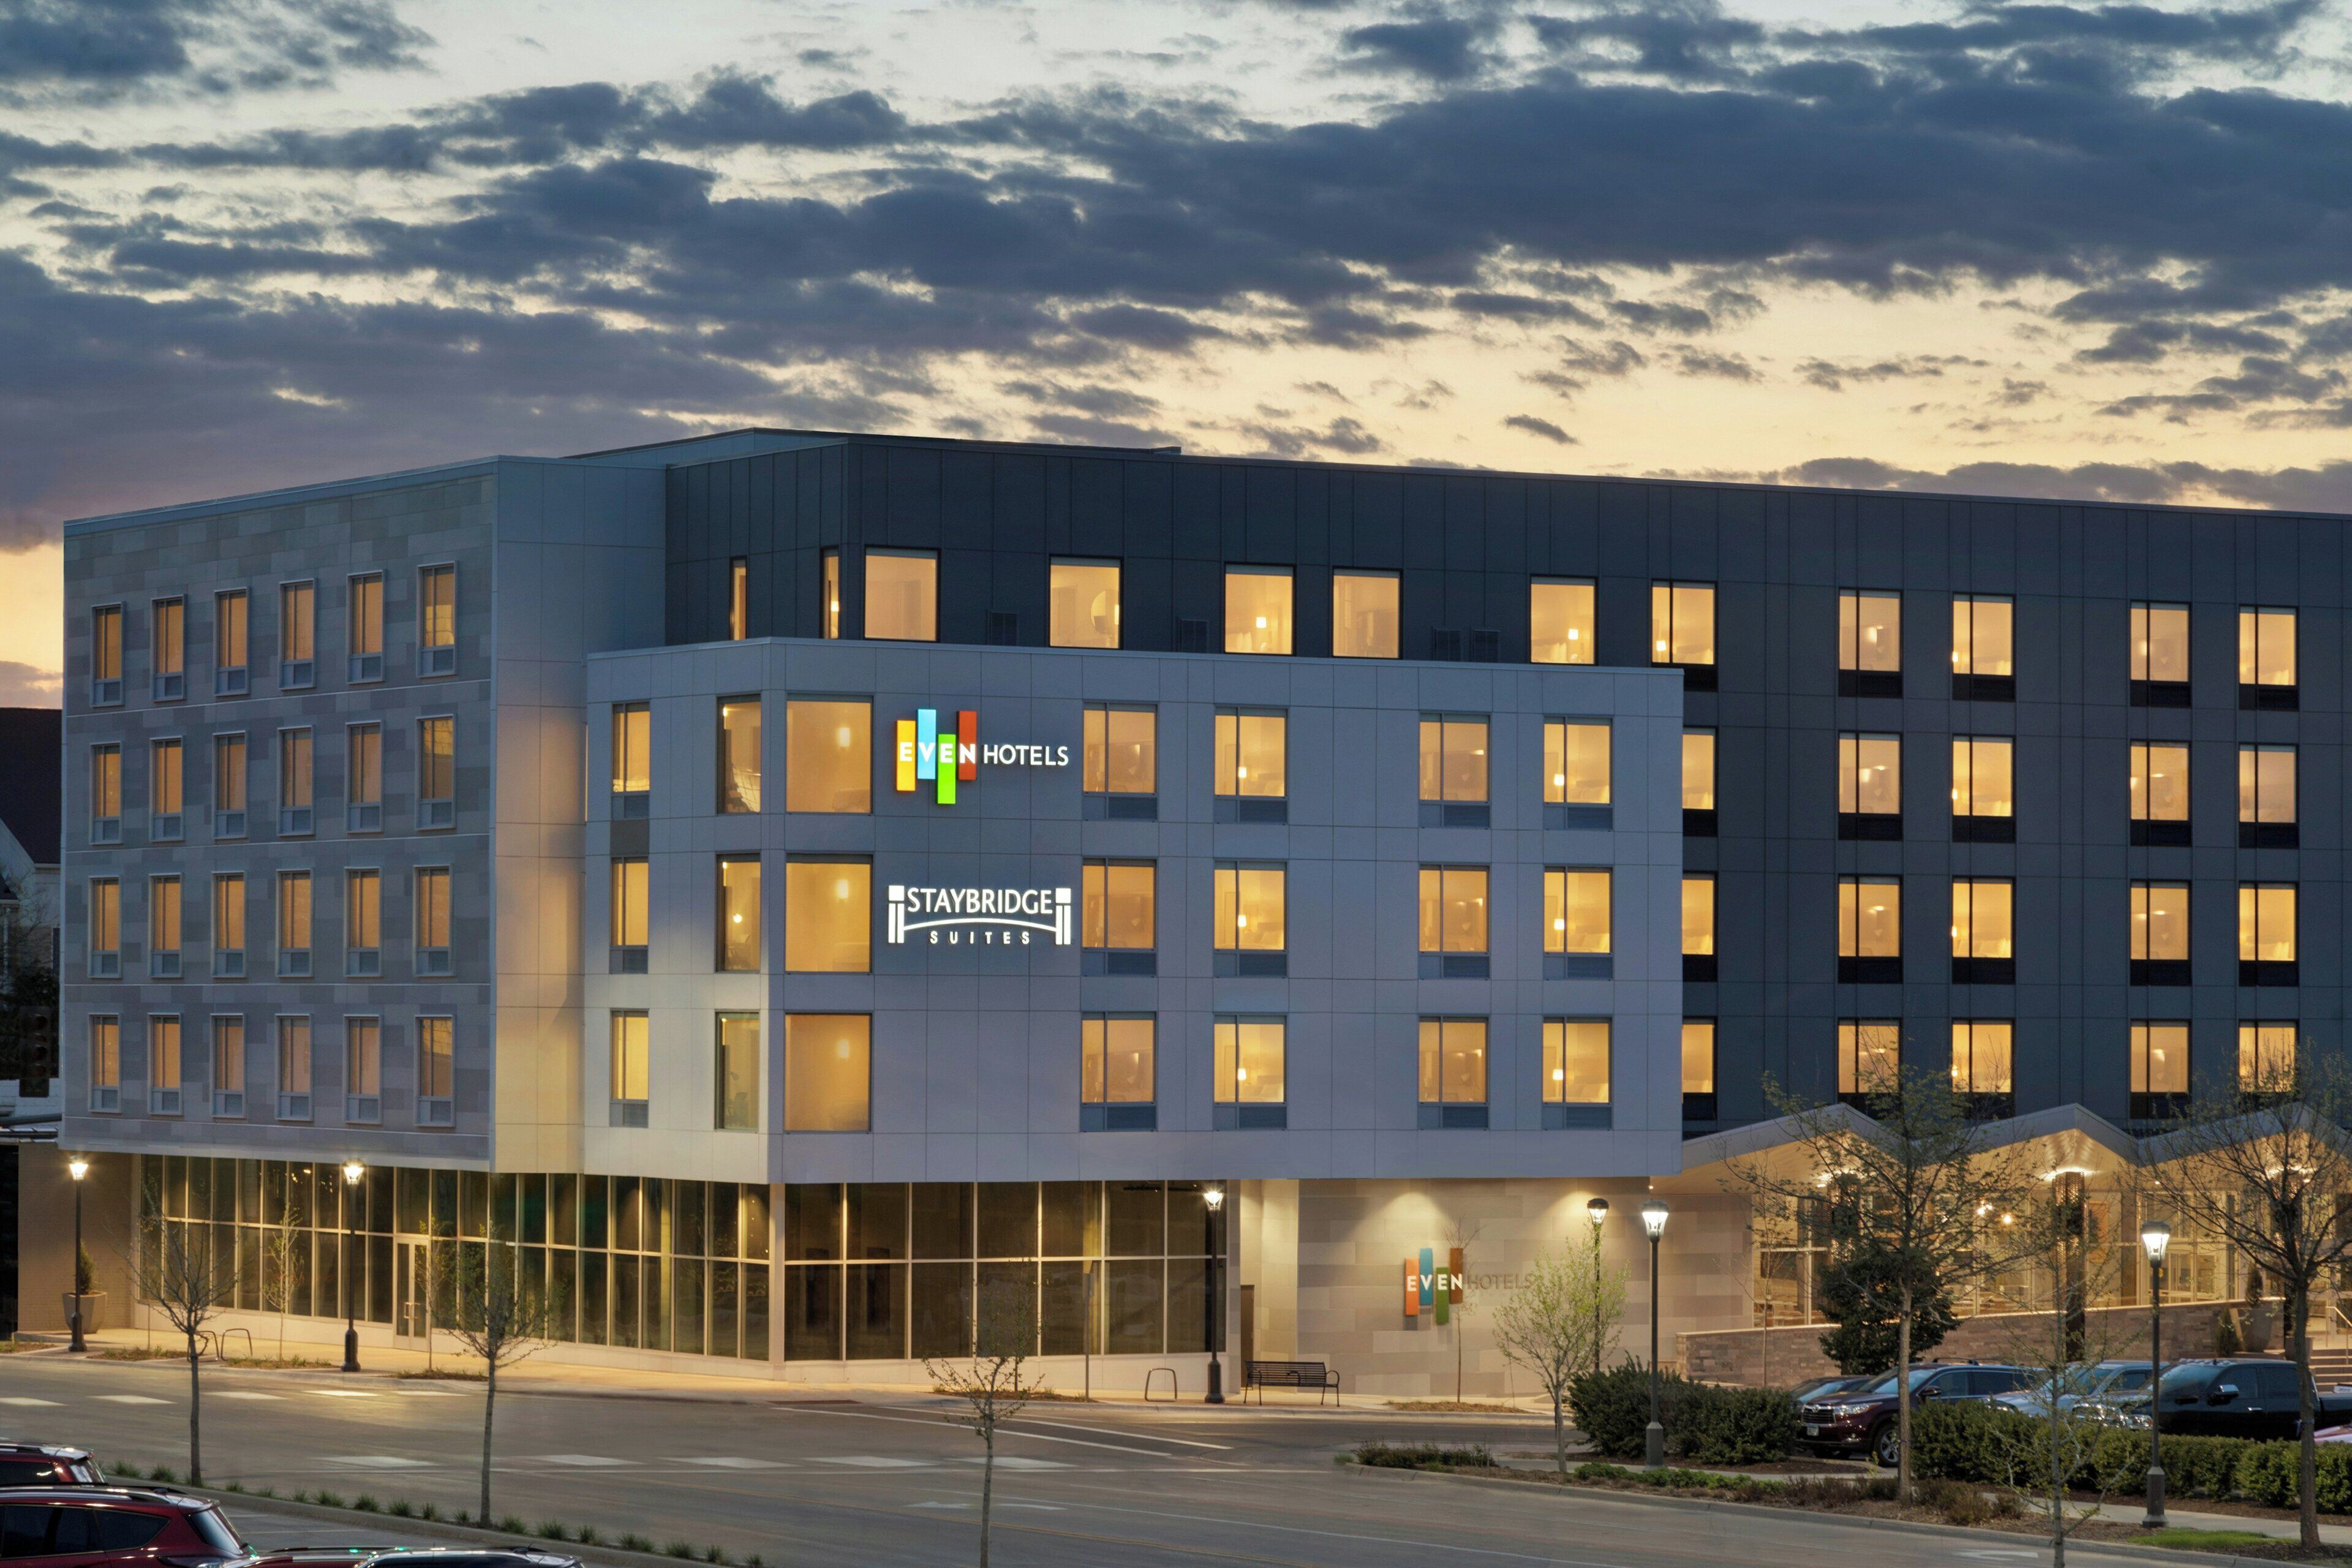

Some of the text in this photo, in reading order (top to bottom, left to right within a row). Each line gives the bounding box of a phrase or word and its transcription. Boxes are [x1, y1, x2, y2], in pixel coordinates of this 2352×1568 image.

[899, 742, 1069, 766] EVEN HOTELS
[907, 887, 1053, 914] STAYBRIDGE
[929, 930, 1030, 944] SUITES
[1407, 1273, 1533, 1292] EVEN HOTELS
